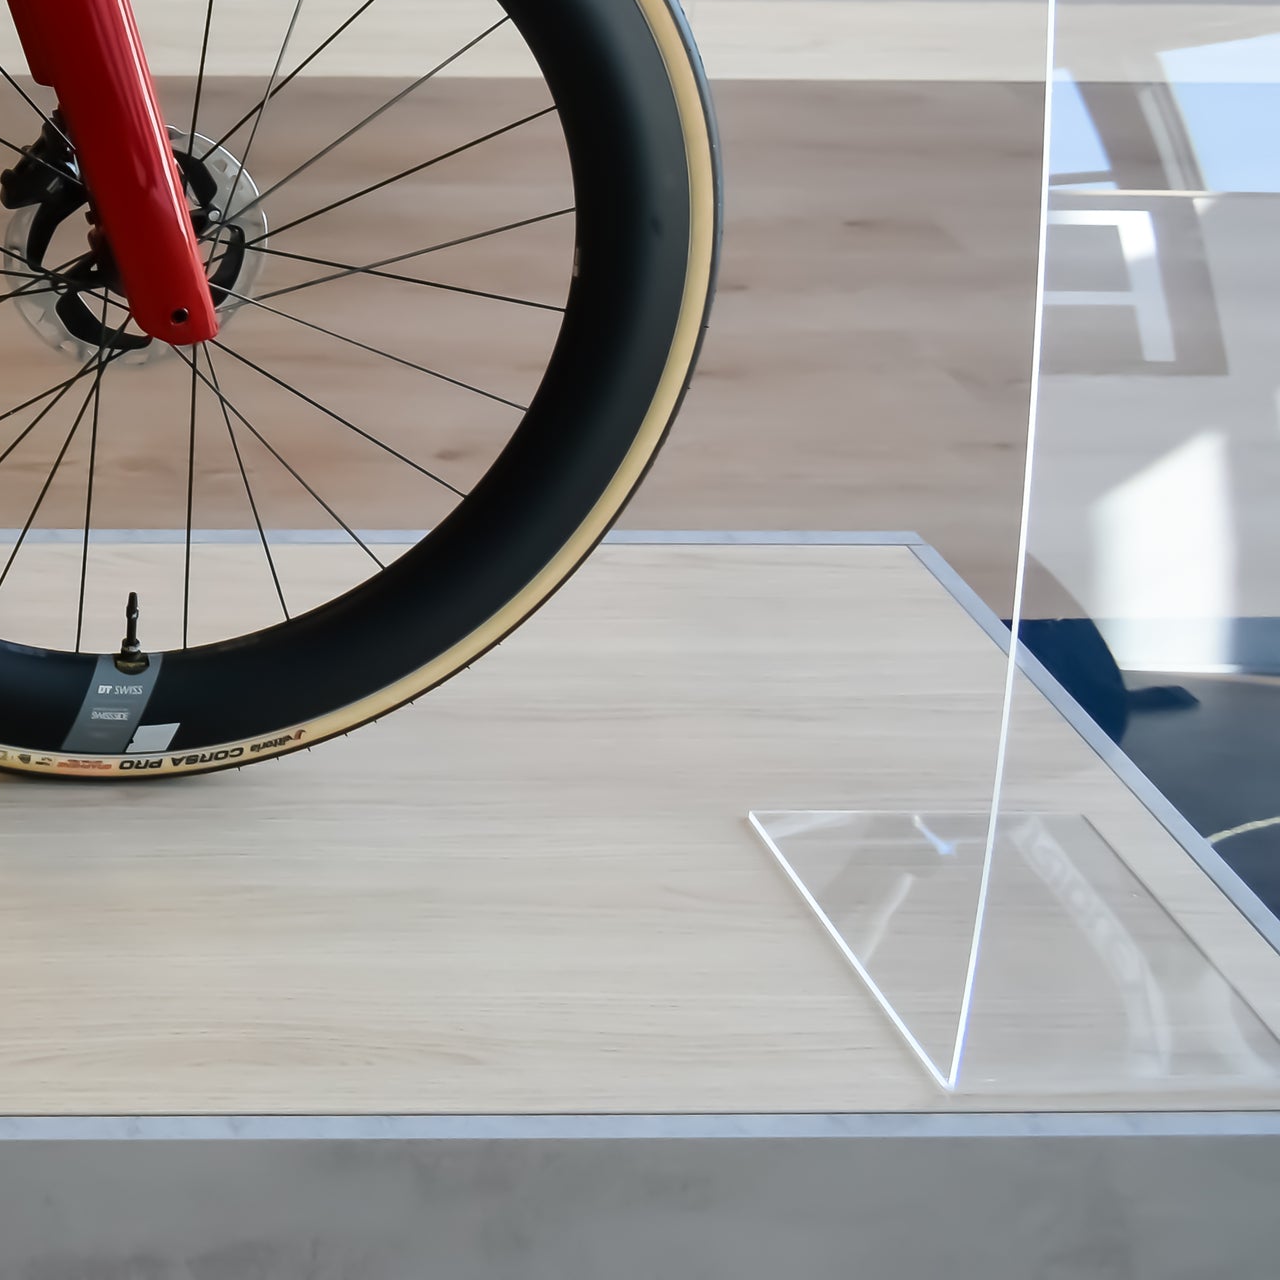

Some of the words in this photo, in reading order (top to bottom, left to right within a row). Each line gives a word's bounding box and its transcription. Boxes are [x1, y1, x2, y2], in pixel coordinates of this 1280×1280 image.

[97, 684, 113, 694] DT
[114, 684, 144, 695] SWISS
[170, 746, 244, 767] CORSA
[119, 757, 163, 771] PRO
